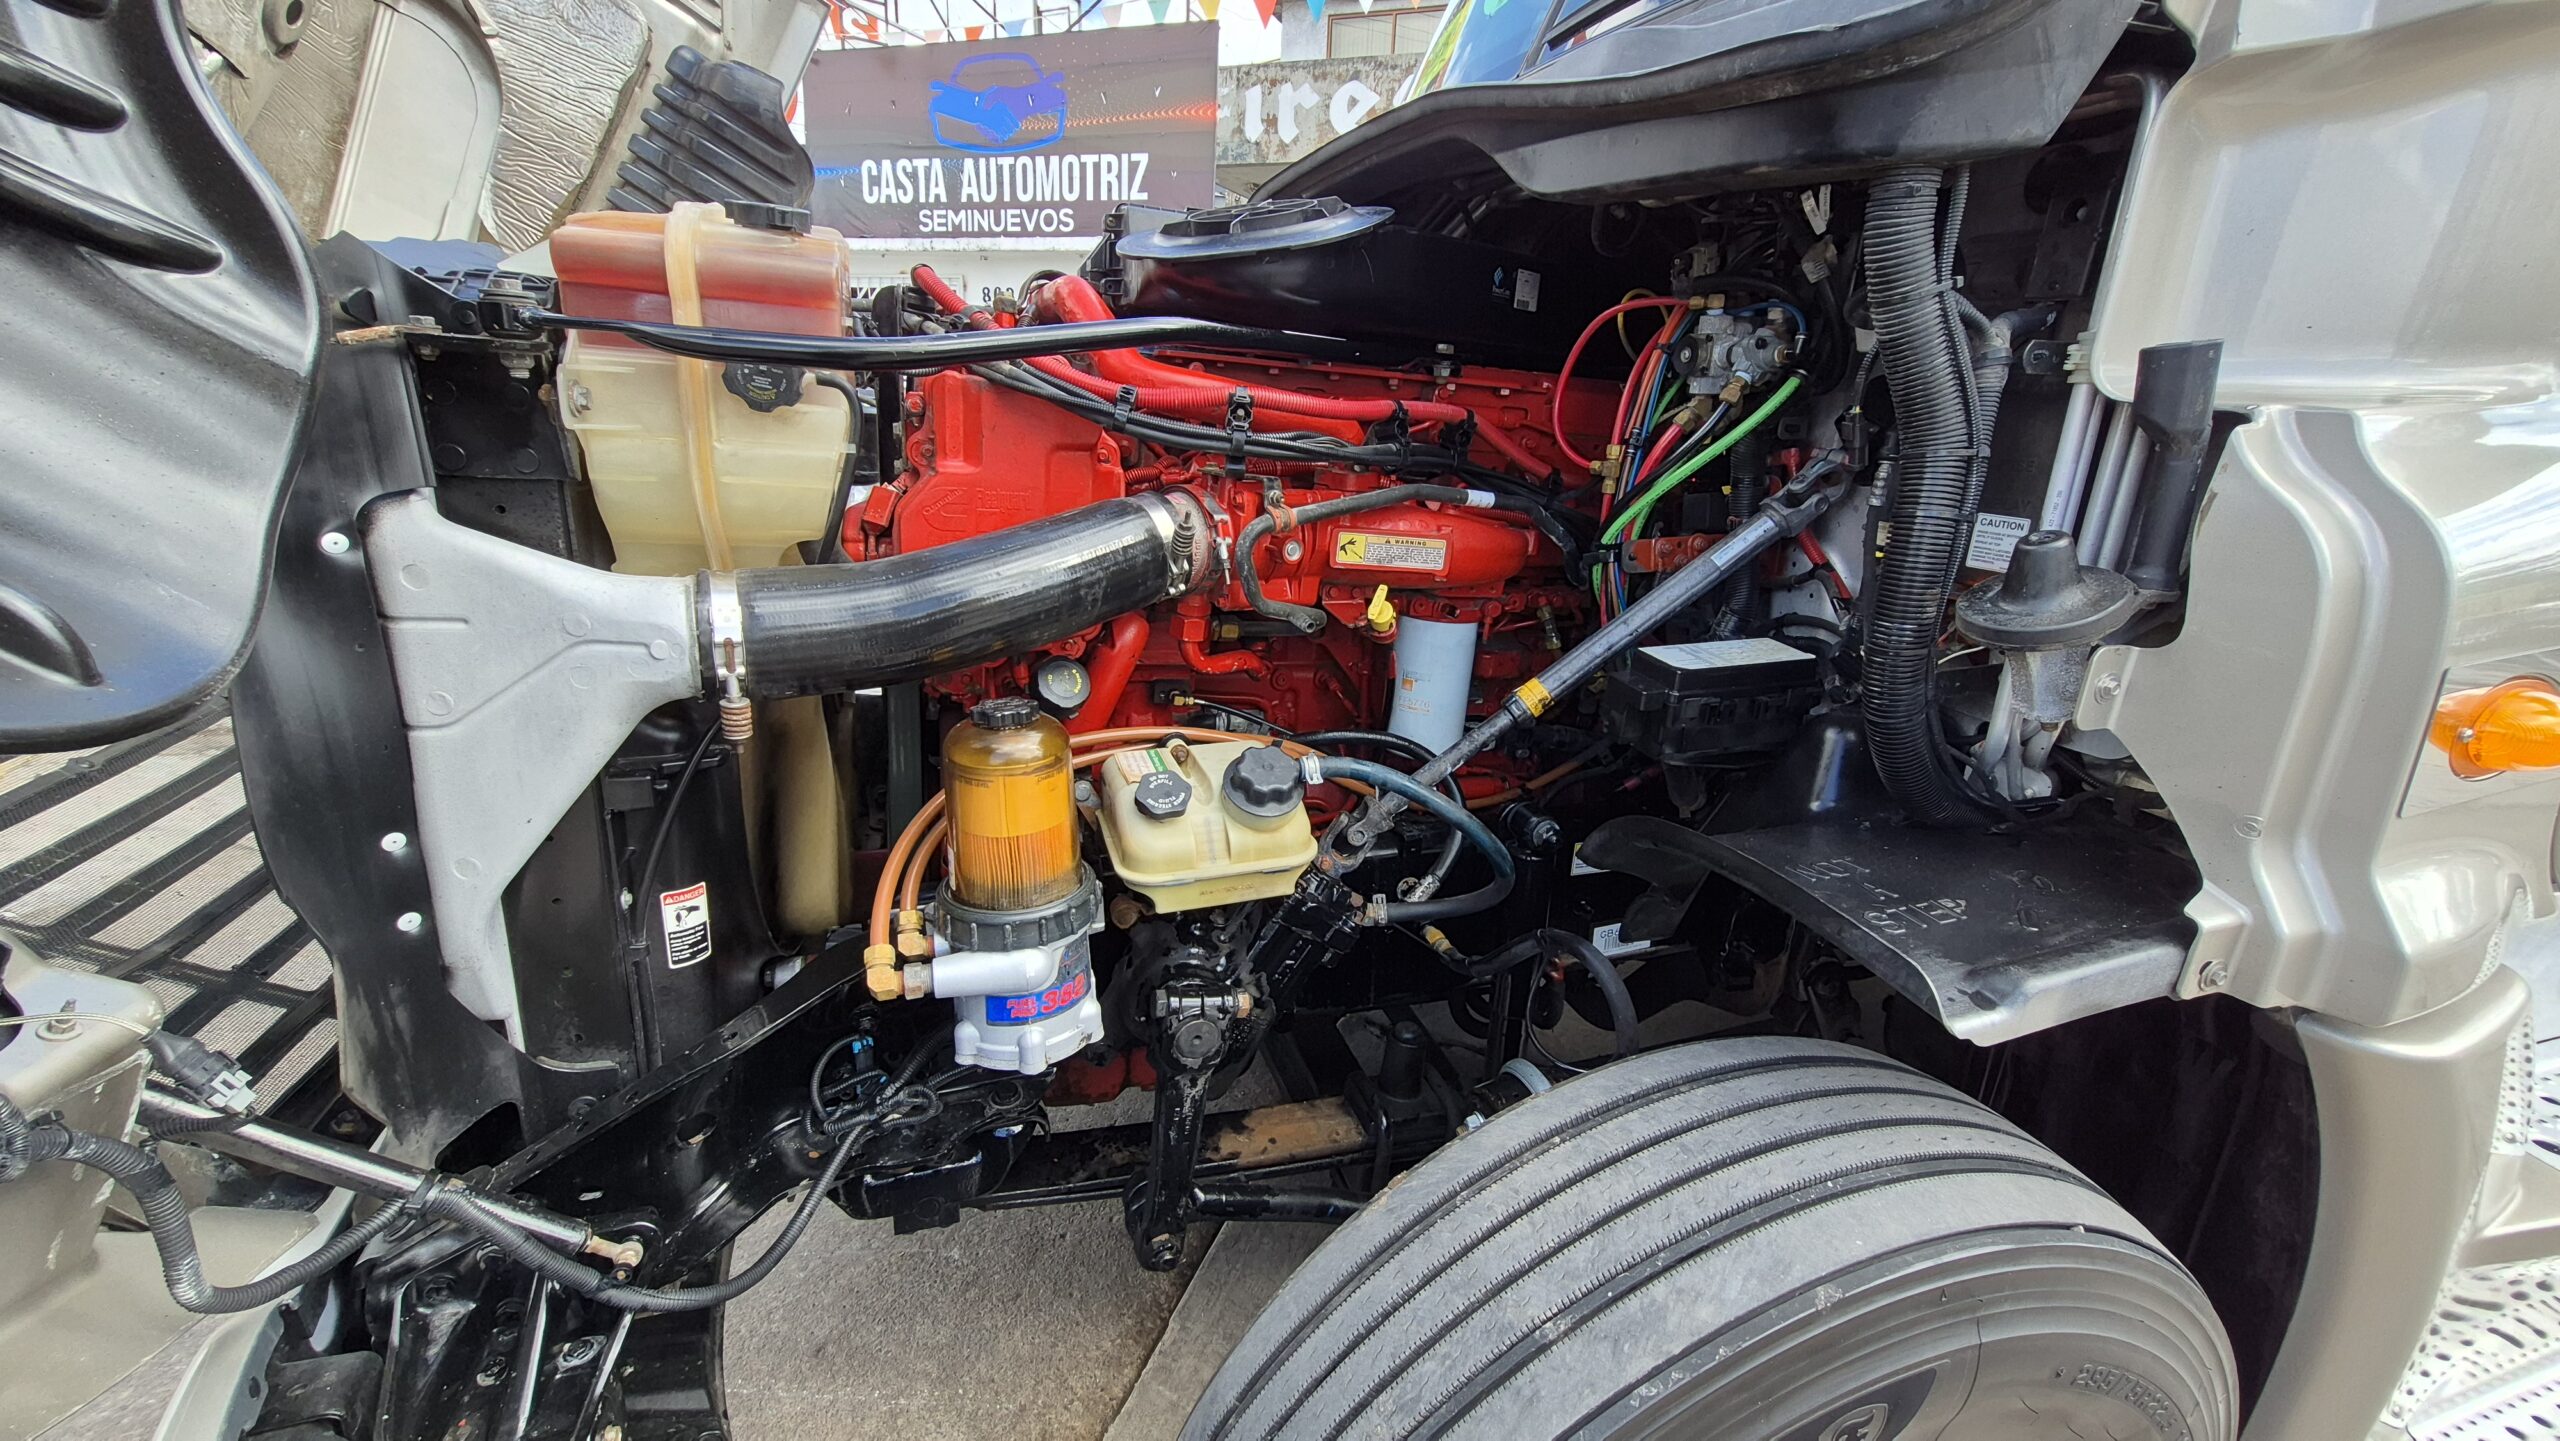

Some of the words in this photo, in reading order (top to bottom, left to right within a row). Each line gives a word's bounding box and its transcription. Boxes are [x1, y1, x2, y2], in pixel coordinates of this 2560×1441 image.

[861, 158, 948, 204] CASTA
[960, 152, 1149, 203] AUTOMOTRIZ
[918, 208, 1075, 232] SEMINUEVOS
[1980, 518, 2025, 531] CAUTION
[673, 887, 704, 902] DANGER
[1007, 996, 1037, 1009] FUEL
